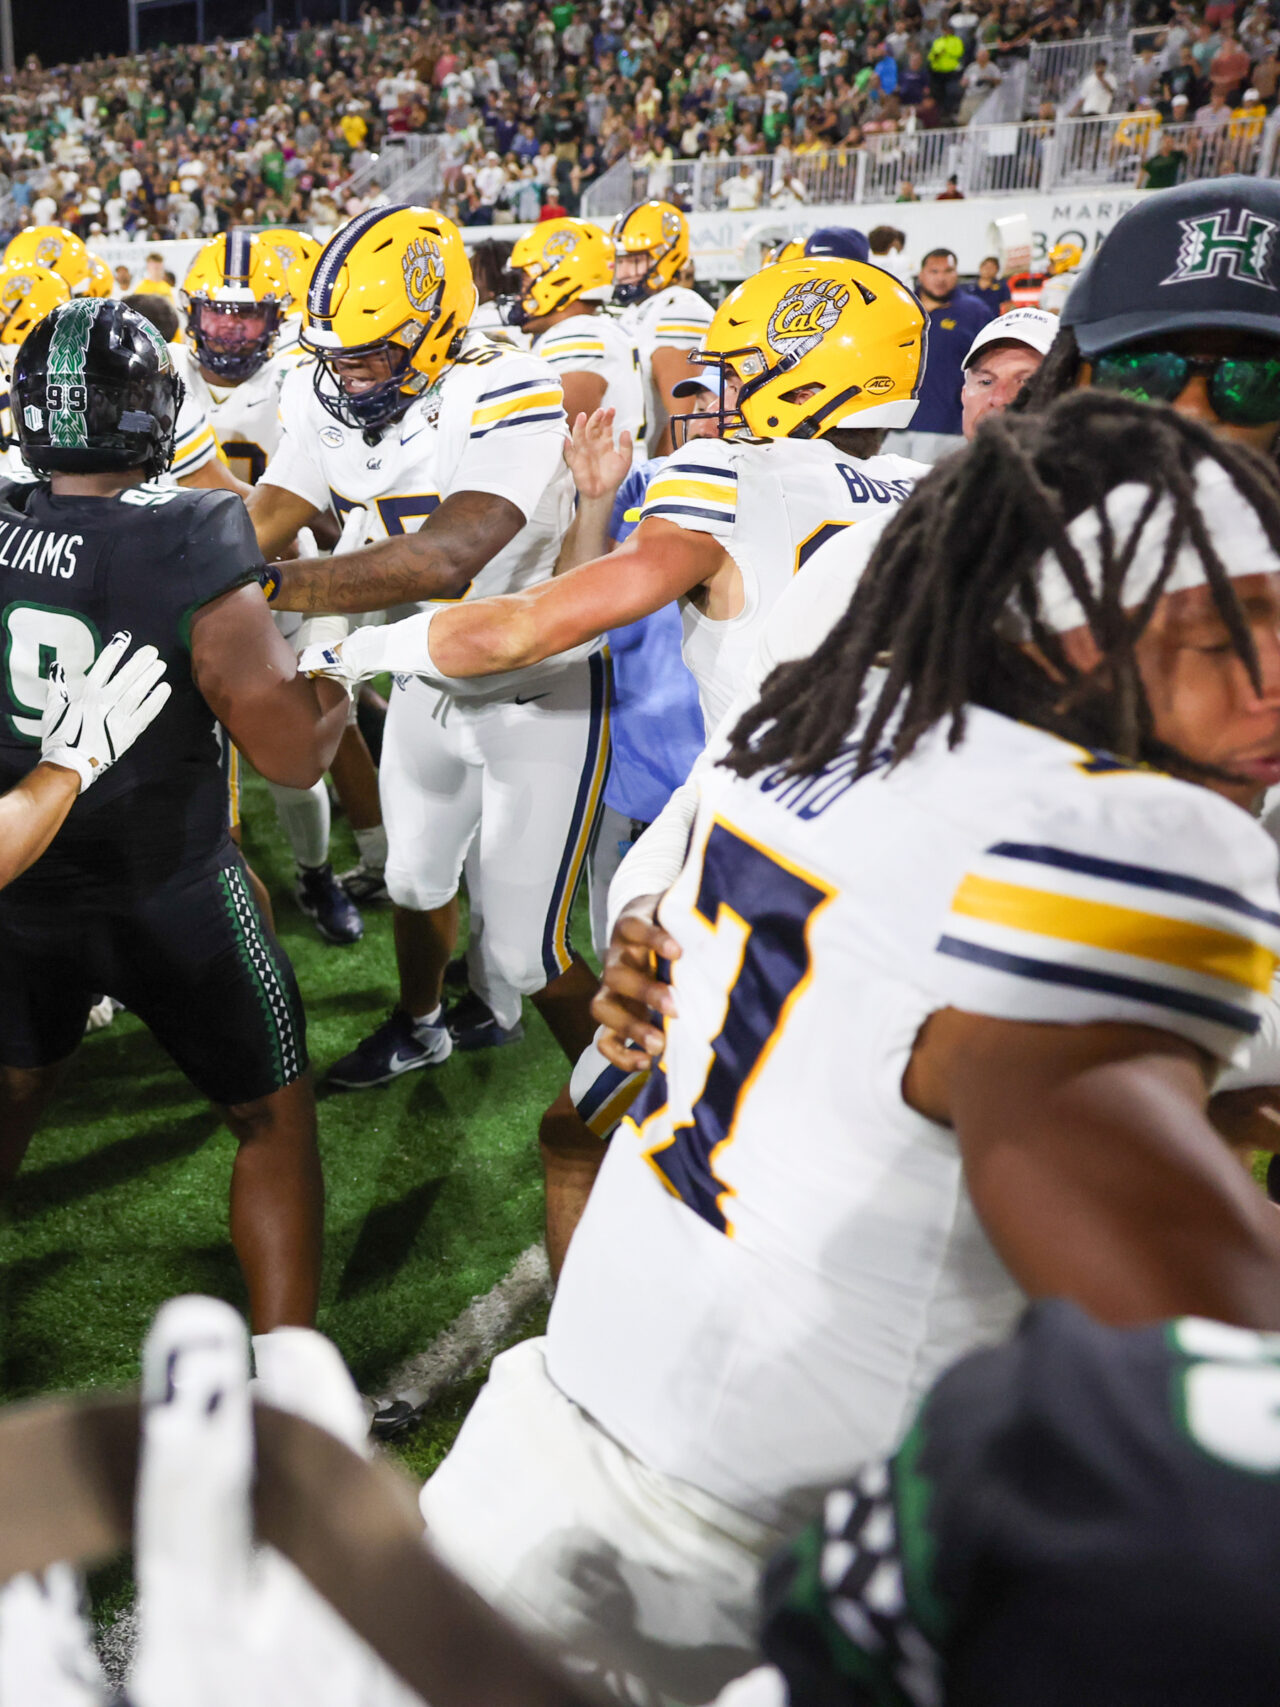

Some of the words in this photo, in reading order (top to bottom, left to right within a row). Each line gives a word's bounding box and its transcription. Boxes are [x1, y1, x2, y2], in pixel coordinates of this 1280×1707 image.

[1158, 207, 1280, 291] H
[410, 258, 444, 305] Cal
[773, 300, 826, 340] Cal
[46, 384, 88, 413] 99
[870, 379, 892, 388] ACC
[366, 457, 383, 471] Cal
